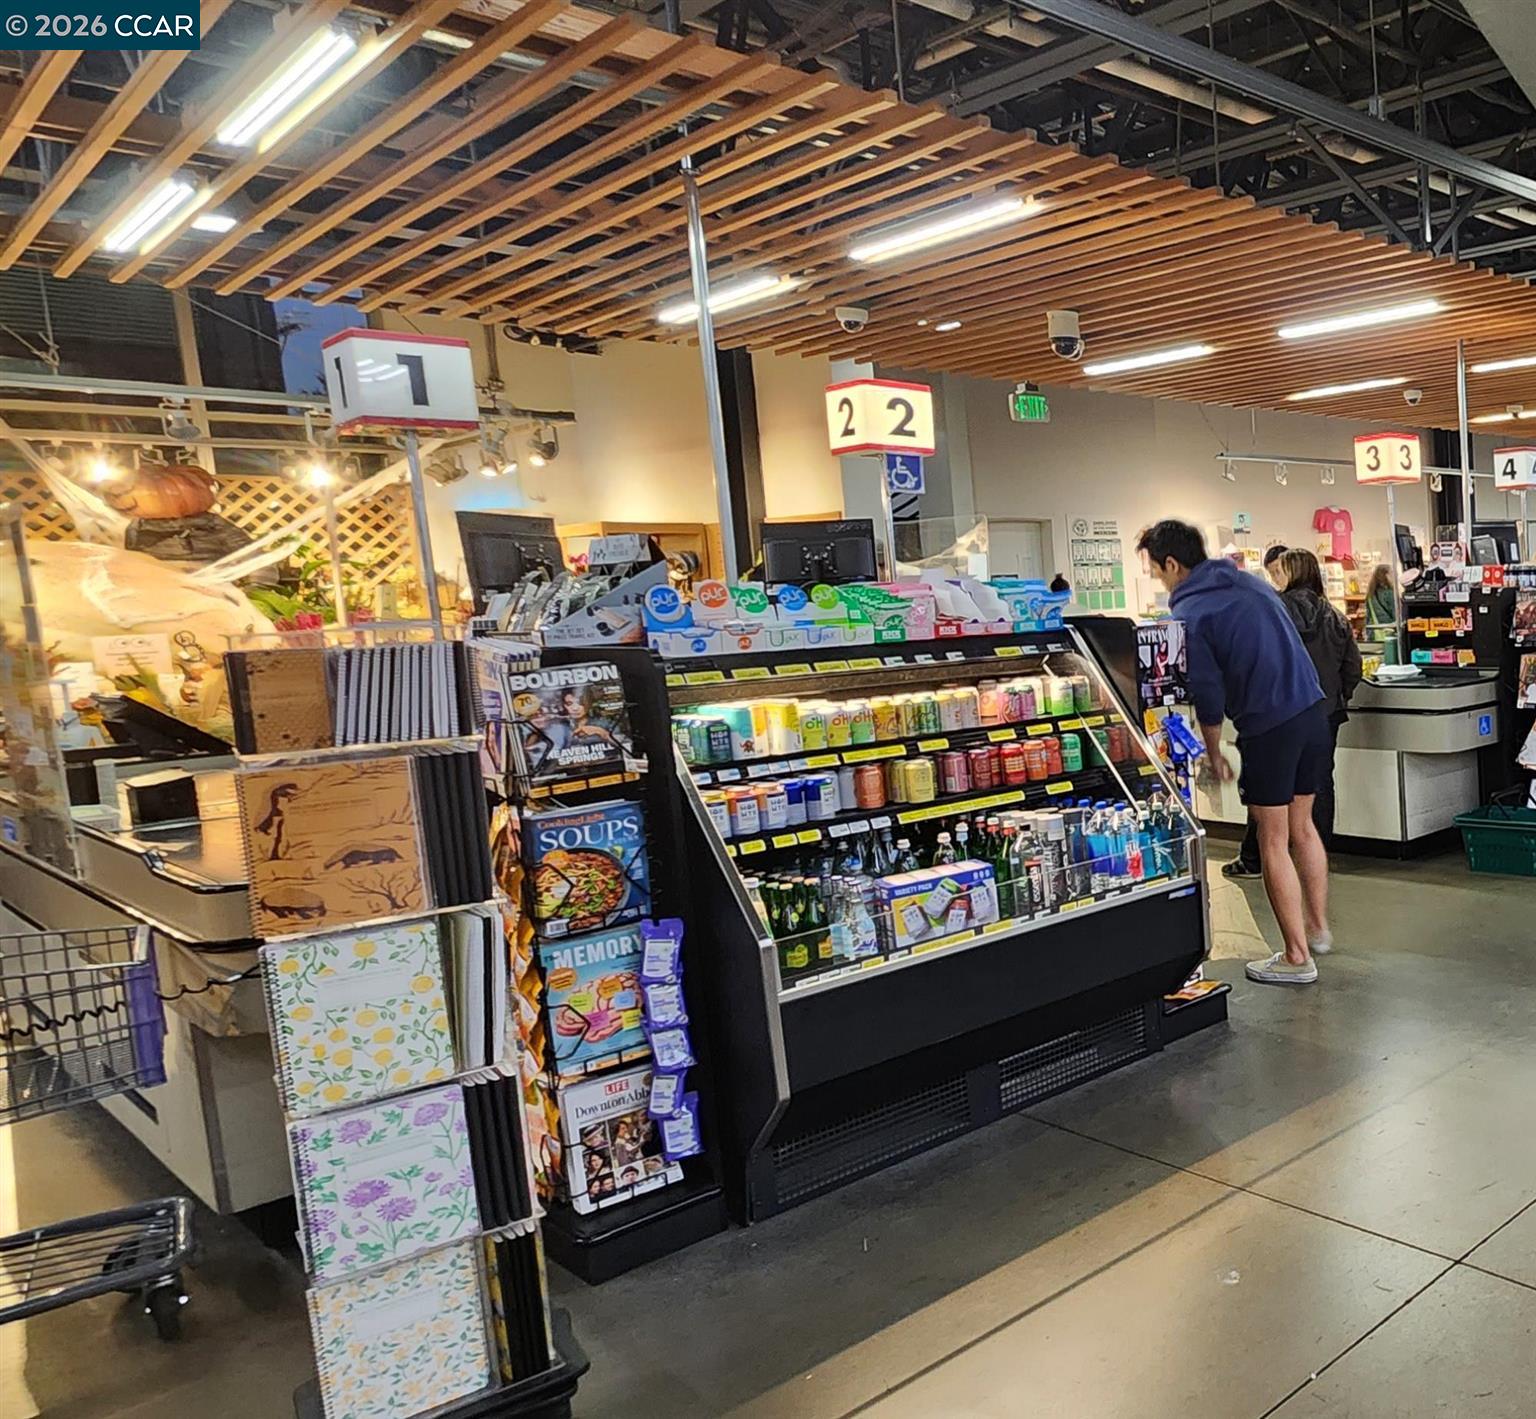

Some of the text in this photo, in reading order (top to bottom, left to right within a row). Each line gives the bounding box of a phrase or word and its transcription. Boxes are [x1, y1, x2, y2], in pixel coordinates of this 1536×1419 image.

[334, 356, 348, 409] 1
[396, 353, 430, 407] 1
[838, 397, 856, 438] 2
[886, 397, 917, 438] 2
[1018, 394, 1046, 420] EXIT
[1366, 445, 1381, 472] 3
[1399, 444, 1412, 470] 3
[1502, 457, 1517, 480] 4
[652, 593, 676, 610] pur
[701, 585, 724, 603] pur
[740, 592, 763, 609] pur
[781, 592, 802, 606] pur
[813, 588, 833, 602] pur
[509, 664, 619, 691] BOURBON
[558, 751, 606, 766] SPRINGS
[539, 815, 639, 852] SOUPS
[553, 934, 642, 970] MEMORY
[606, 1080, 630, 1096] LIFE
[575, 1086, 651, 1119] Downton Abb
